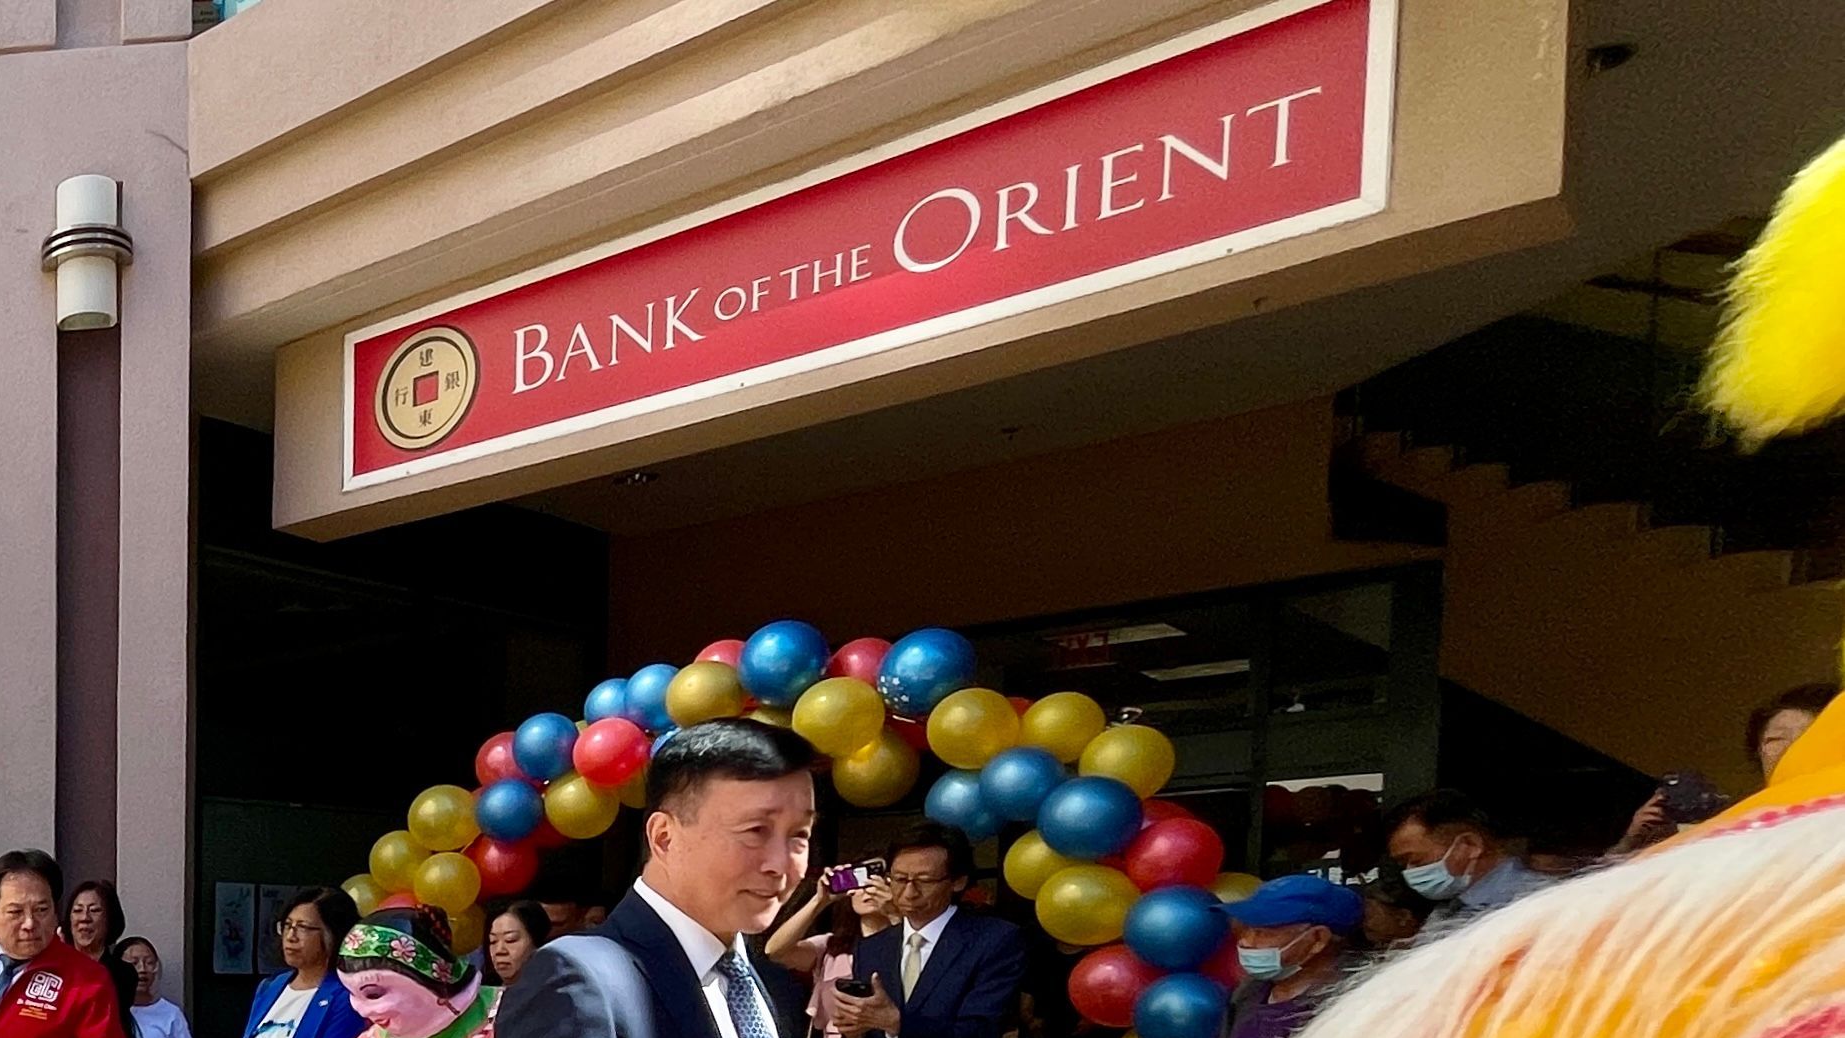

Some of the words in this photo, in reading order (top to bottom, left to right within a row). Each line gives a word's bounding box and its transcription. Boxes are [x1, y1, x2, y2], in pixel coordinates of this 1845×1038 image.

[511, 286, 707, 395] BANK
[712, 277, 772, 322] OF
[779, 243, 873, 302] THE
[892, 85, 1323, 274] ORIENT
